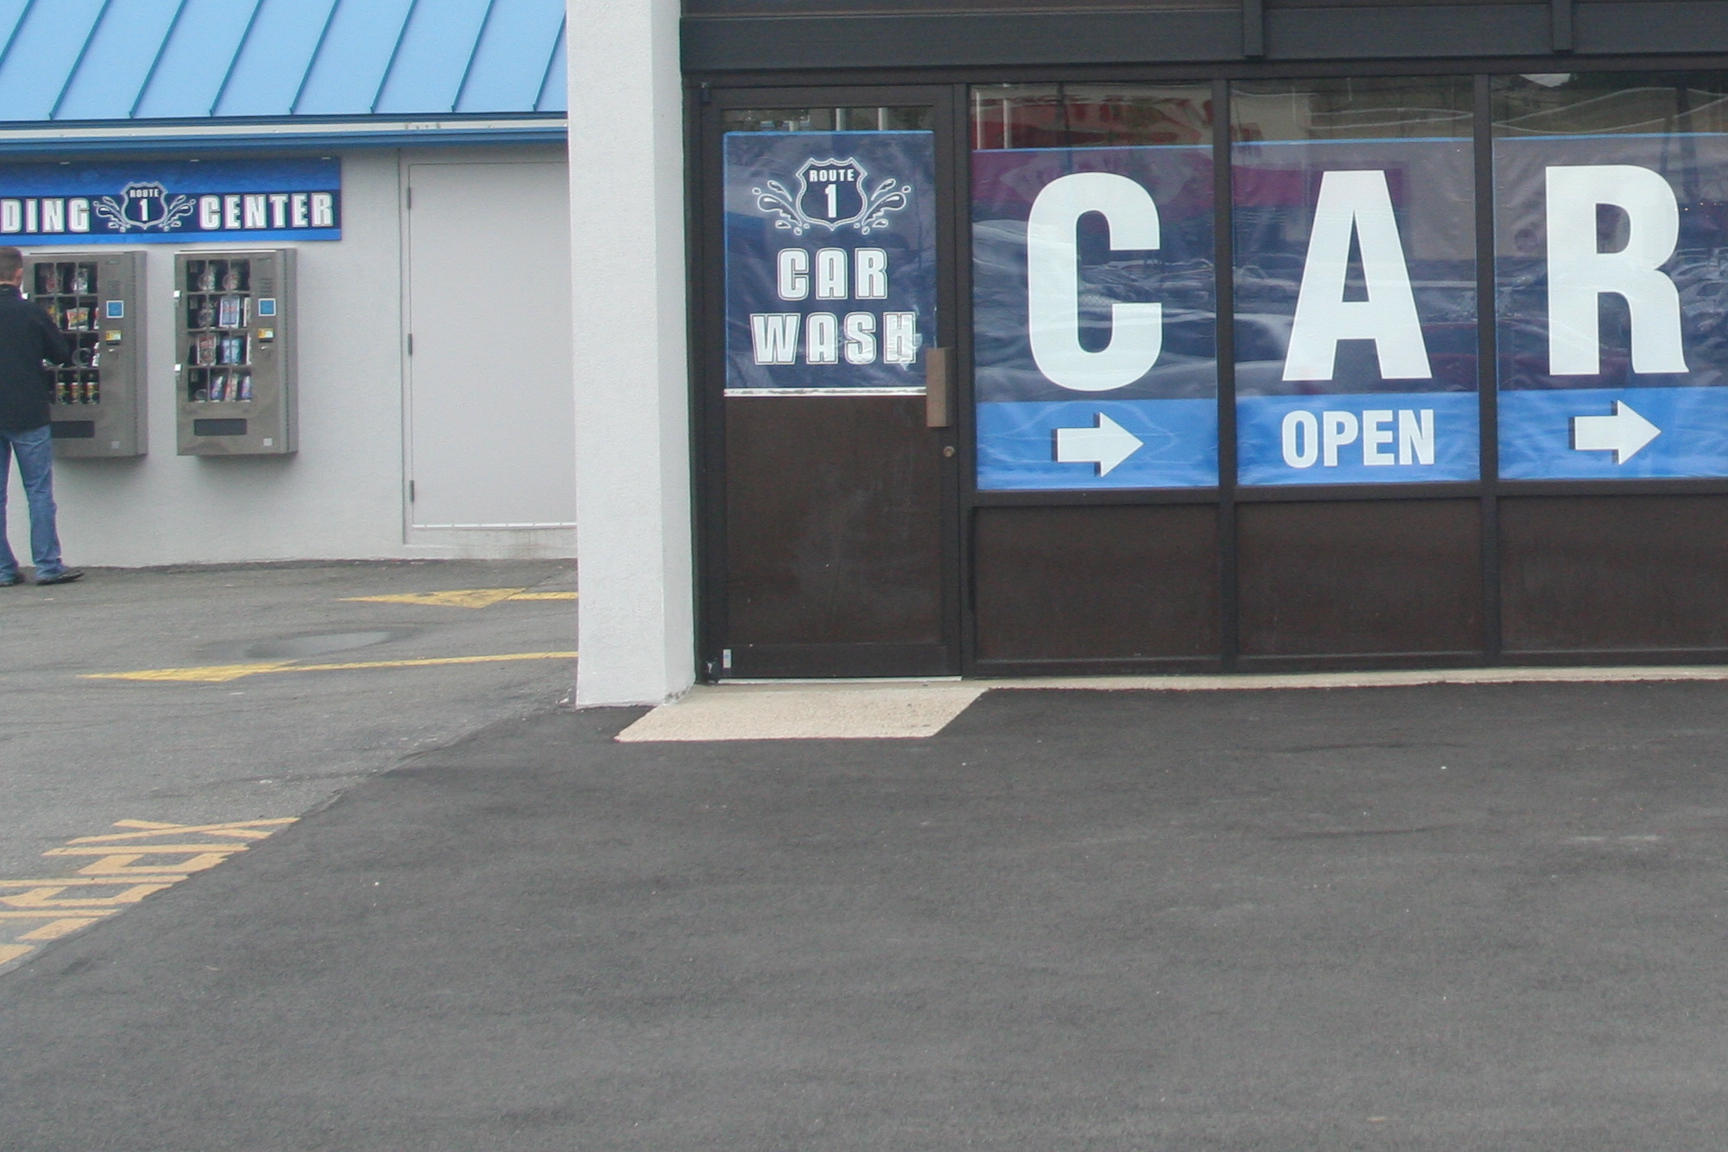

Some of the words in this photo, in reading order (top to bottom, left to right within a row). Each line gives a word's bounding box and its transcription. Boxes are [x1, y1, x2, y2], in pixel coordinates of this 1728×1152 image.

[129, 189, 159, 198] ROUTE
[809, 169, 855, 183] ROUTE
[139, 198, 149, 222] 1
[200, 192, 334, 231] CENTER
[824, 184, 838, 219] 1
[776, 247, 888, 301] CAR
[1026, 164, 1690, 391] CAR
[750, 311, 917, 365] WASH
[1281, 408, 1435, 469] OPEN
